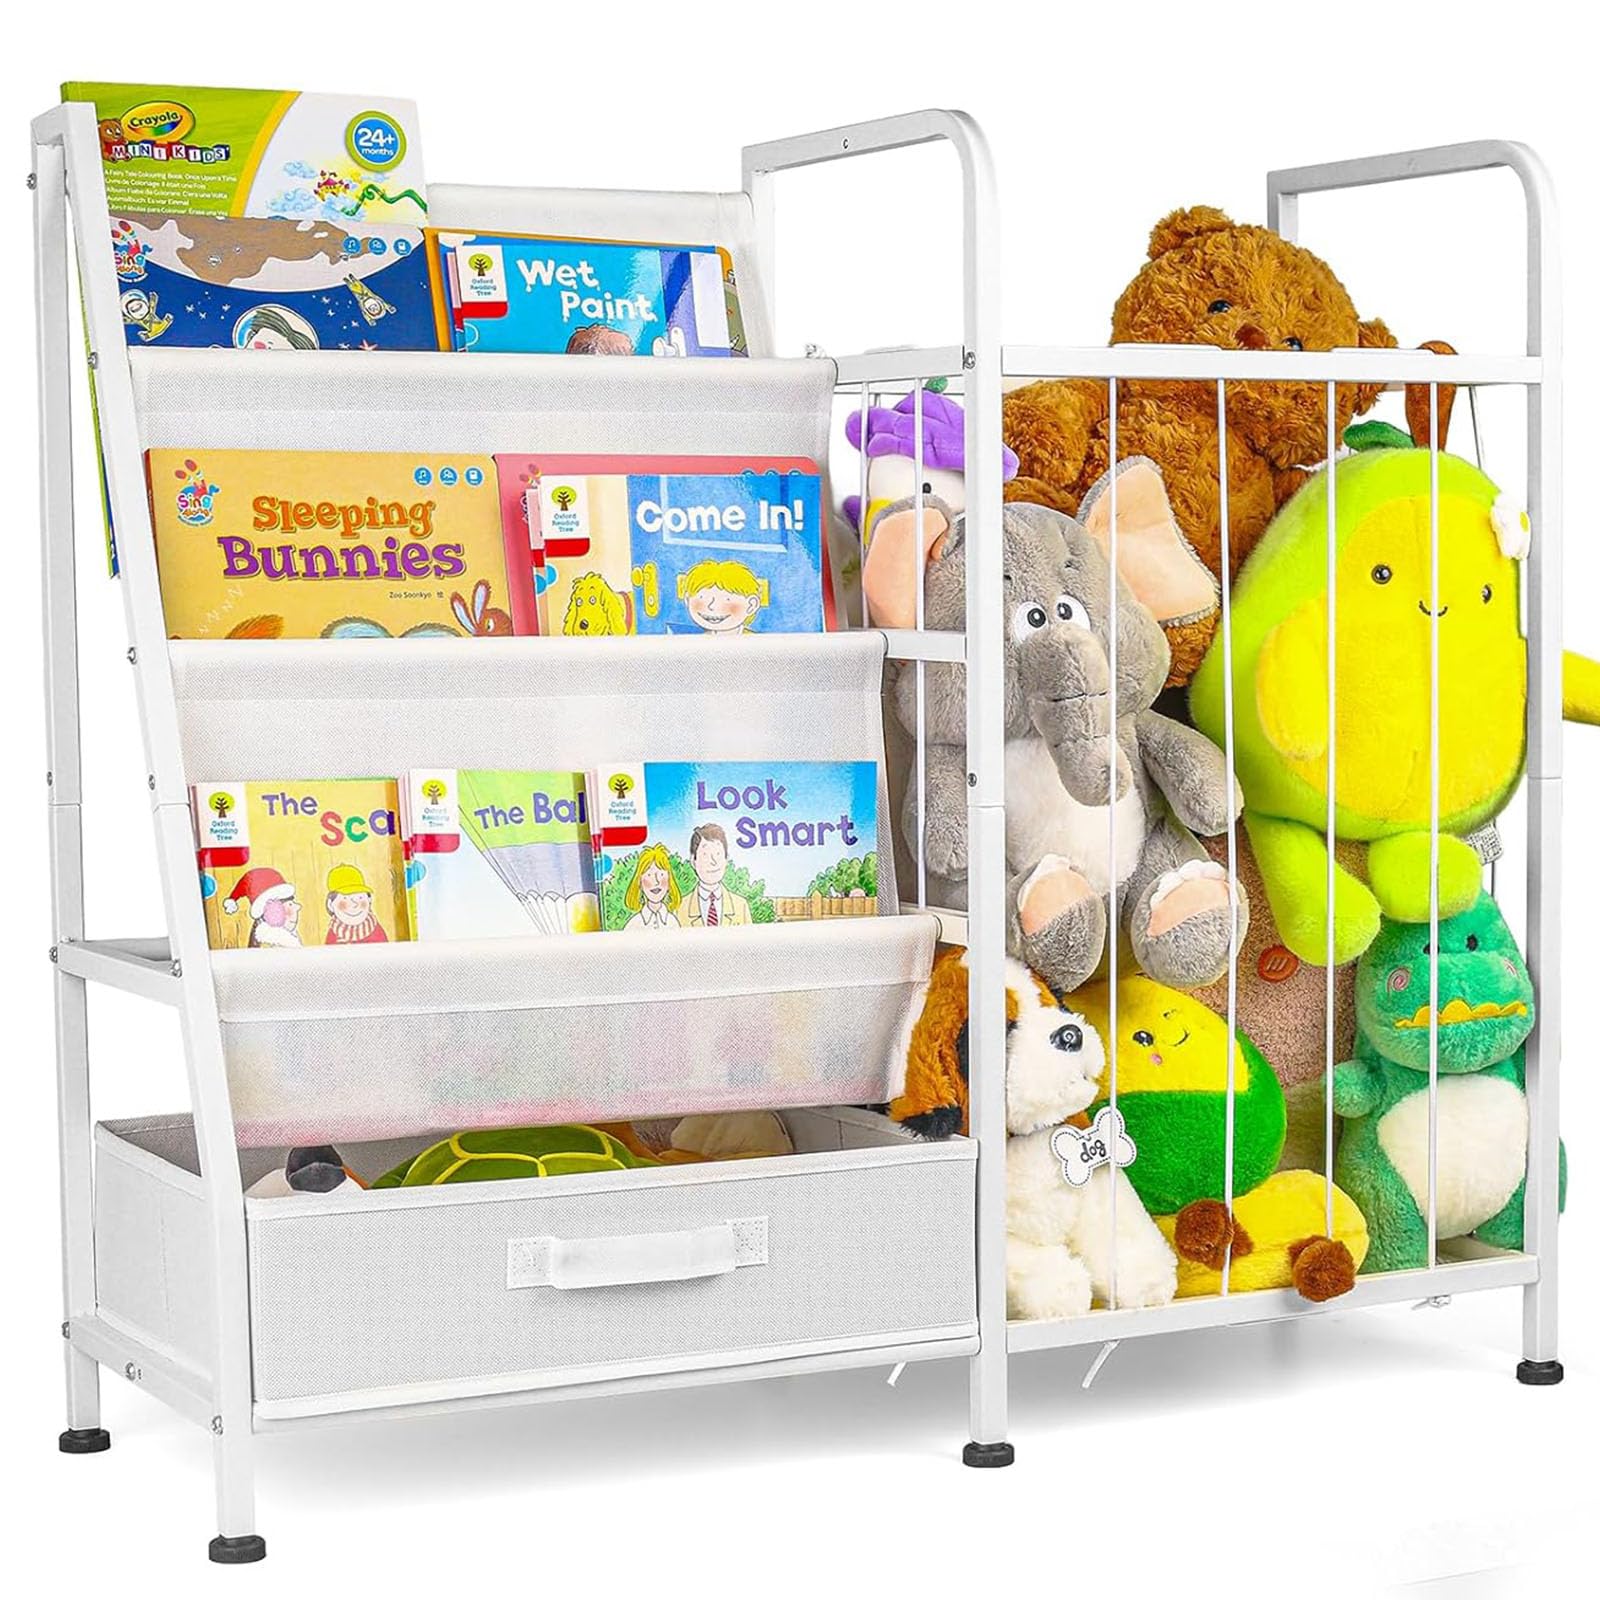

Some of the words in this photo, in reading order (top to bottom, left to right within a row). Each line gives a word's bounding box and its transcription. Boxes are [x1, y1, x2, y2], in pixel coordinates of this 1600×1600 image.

[130, 111, 178, 127] Crayola
[357, 128, 395, 147] 24+
[112, 143, 166, 160] MINI
[172, 144, 226, 162] KIDS
[361, 148, 394, 156] months
[110, 169, 125, 178] Fairy
[138, 171, 167, 180] Colouring
[516, 258, 599, 292] Wet
[560, 290, 659, 322] Paint
[178, 494, 213, 509] Sing
[252, 495, 435, 540] Sleeping
[551, 519, 580, 527] Reading
[553, 512, 577, 520] Oxford
[635, 499, 746, 533] Come
[758, 499, 804, 531] In!
[217, 535, 467, 582] Bunnies
[261, 792, 318, 817] The
[696, 779, 788, 812] Look
[473, 804, 525, 830] The
[532, 791, 586, 824] Bal
[608, 807, 638, 815] Reading
[209, 827, 239, 835] Reading
[211, 820, 236, 828] Oxford
[320, 809, 396, 847] Sca
[735, 814, 859, 848] Smart
[1079, 1139, 1107, 1163] dog
